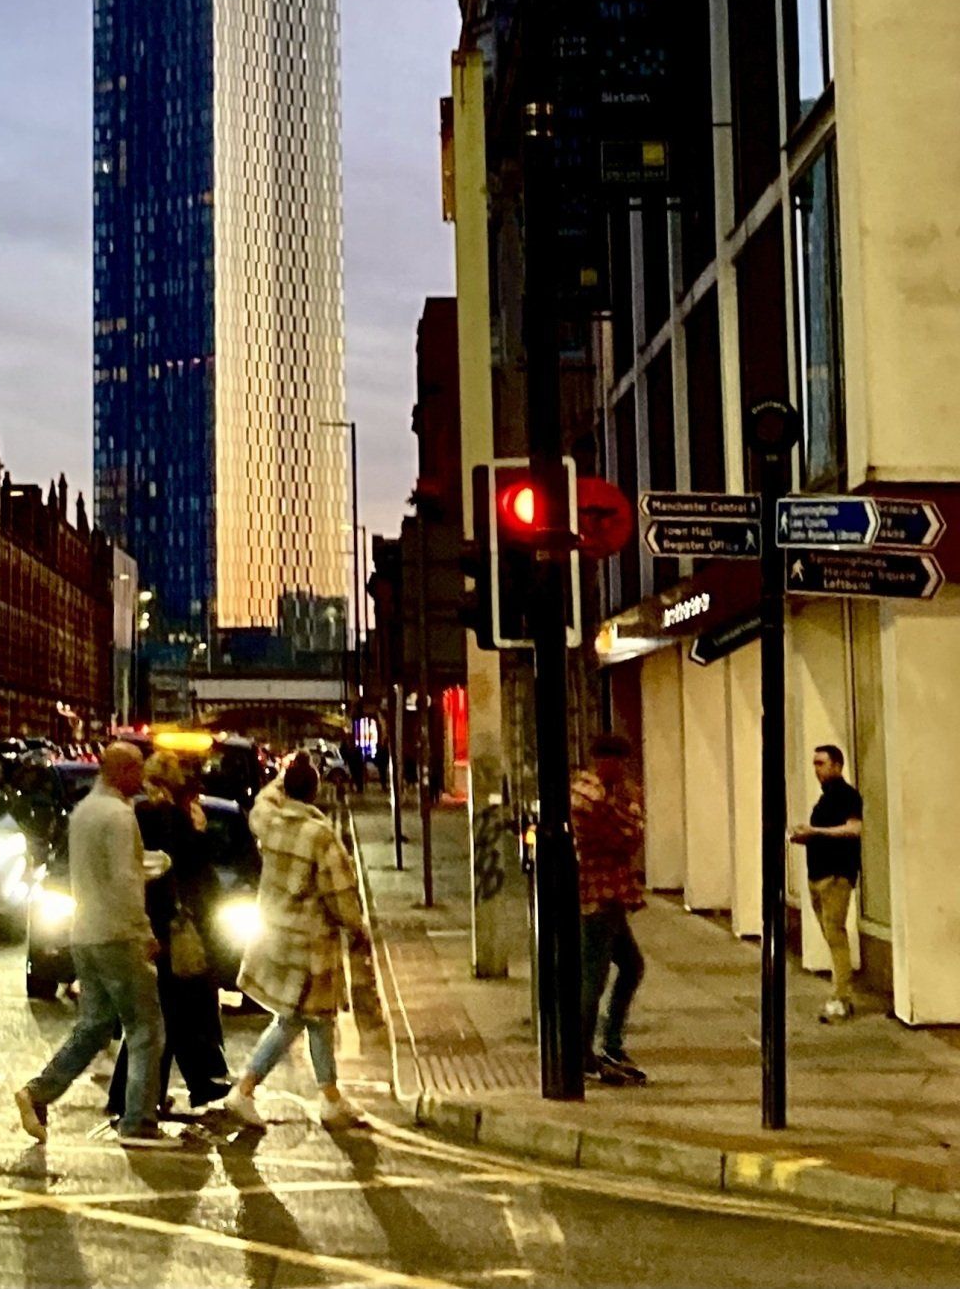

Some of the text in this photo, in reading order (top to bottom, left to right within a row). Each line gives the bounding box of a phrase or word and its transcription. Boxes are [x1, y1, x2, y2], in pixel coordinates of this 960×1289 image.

[651, 500, 747, 513] Manchester Central
[691, 527, 713, 537] Hall
